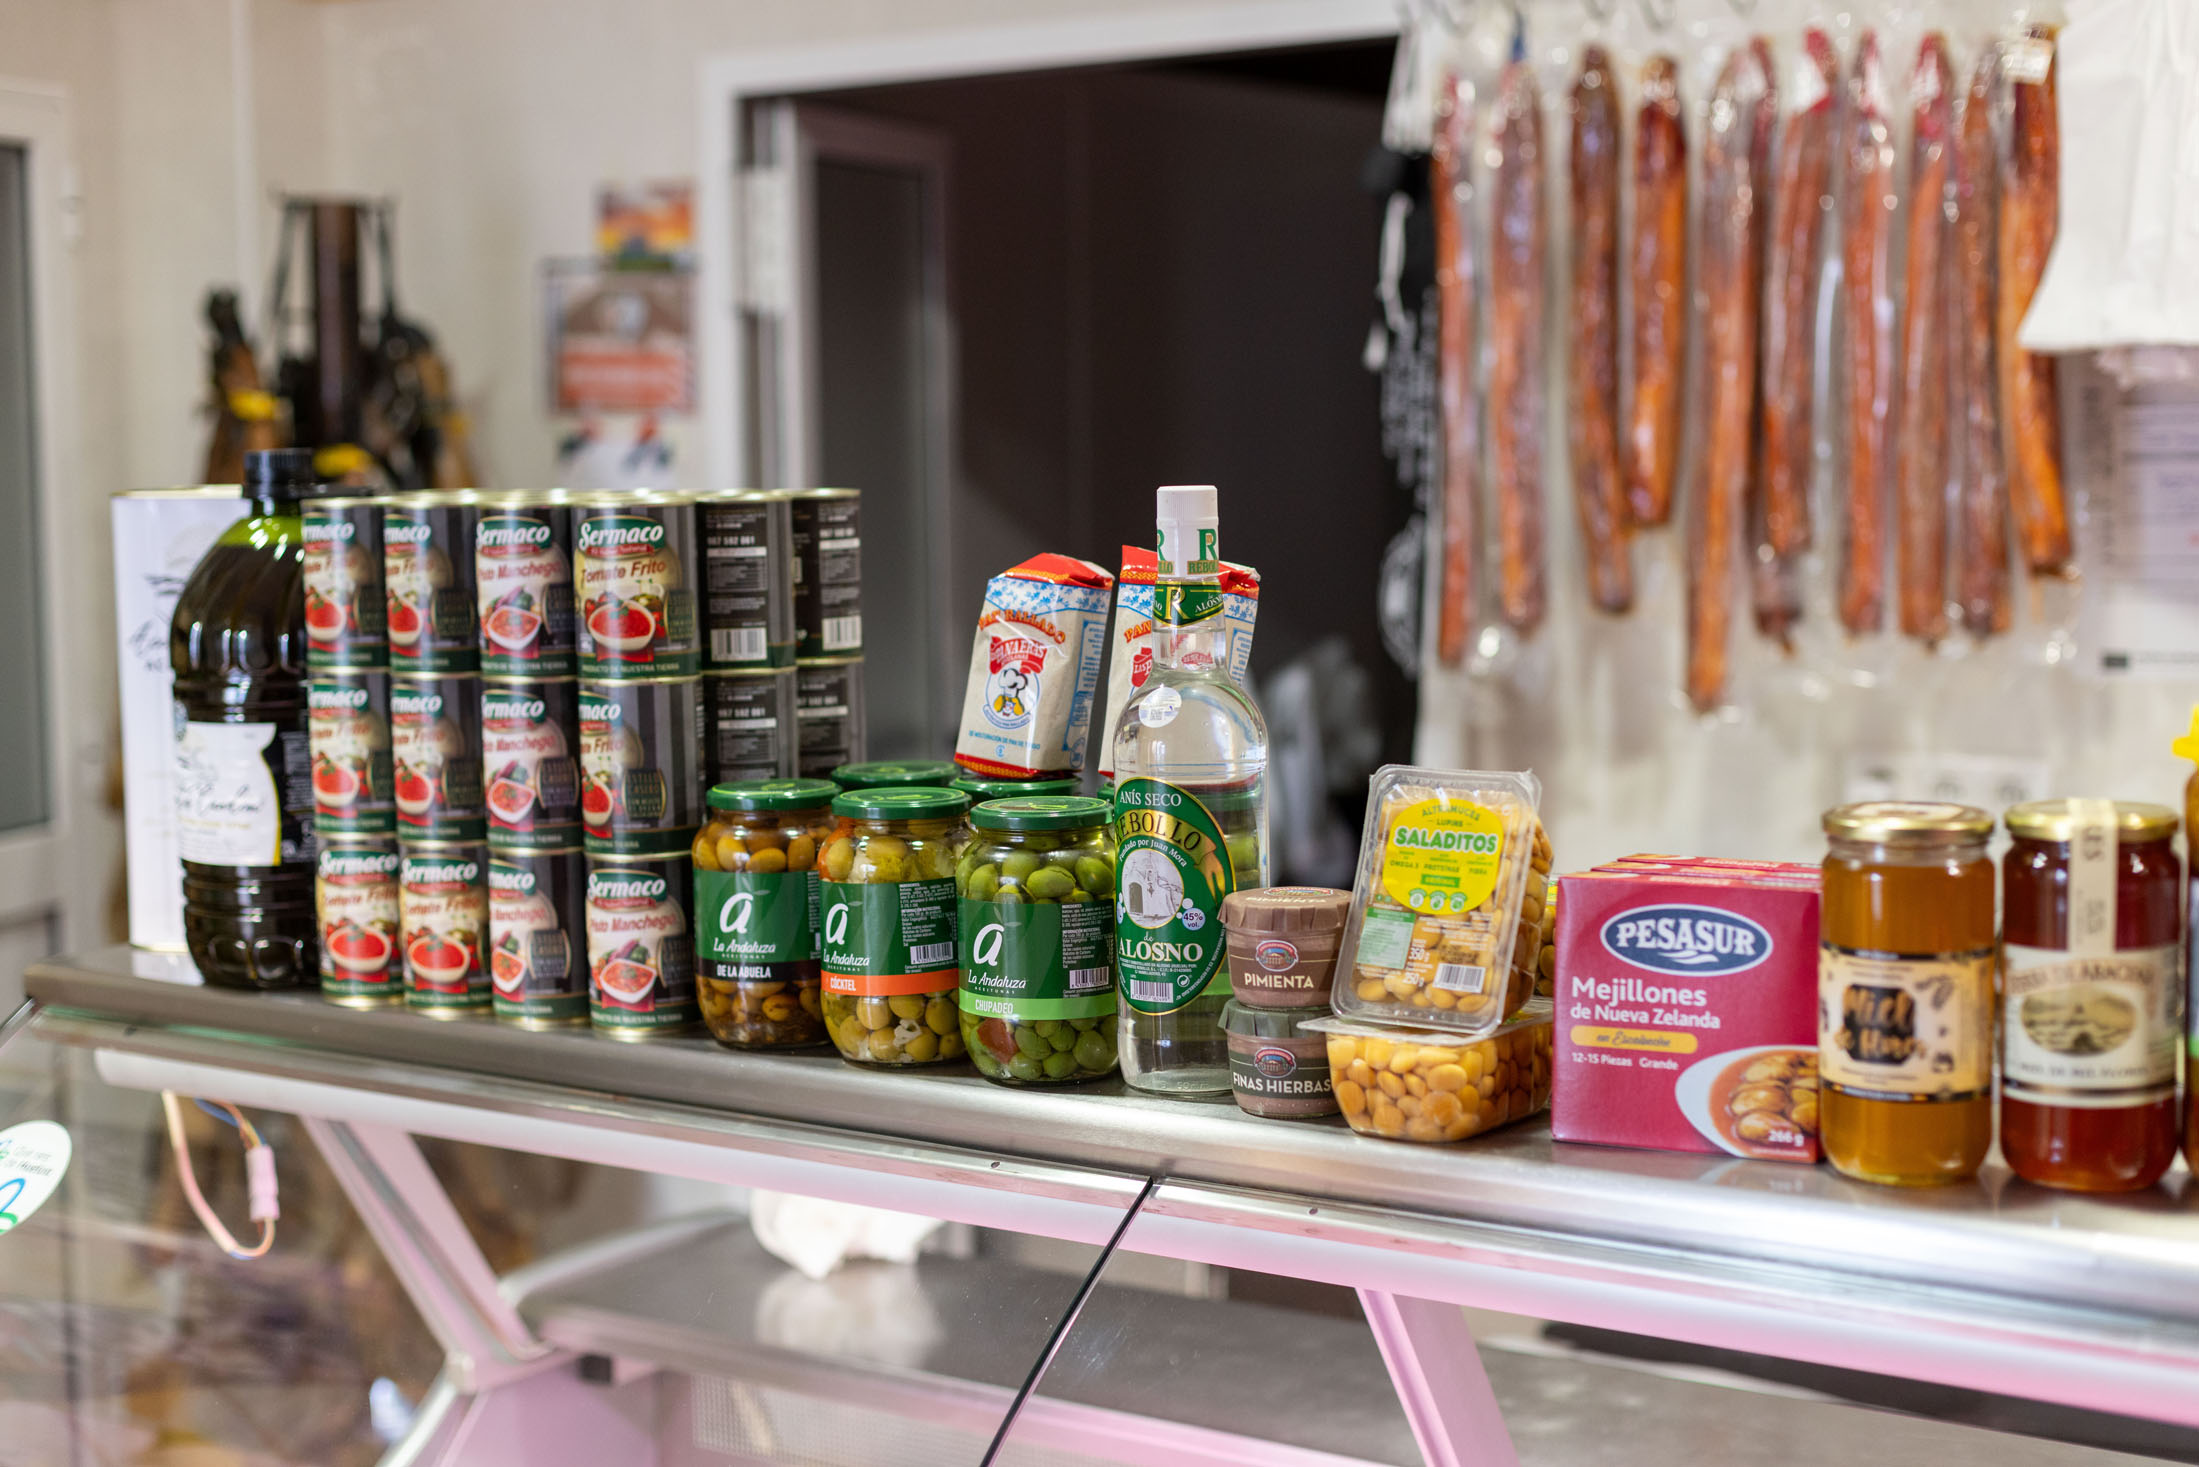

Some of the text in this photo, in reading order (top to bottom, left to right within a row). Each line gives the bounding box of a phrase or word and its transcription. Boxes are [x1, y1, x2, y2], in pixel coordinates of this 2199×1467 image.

[579, 522, 664, 551] Sermaco
[1196, 529, 1219, 561] R
[630, 558, 667, 577] Frito
[1004, 609, 1066, 645] RALLADO
[1124, 620, 1152, 643] PAN
[1120, 788, 1182, 807] ANÍS SECO
[1395, 826, 1498, 854] SALADITOS
[1137, 839, 1149, 848] por
[1150, 840, 1169, 852] Juan
[1168, 847, 1188, 868] Mora
[588, 874, 666, 899] Sermaco
[1182, 912, 1204, 922] 45%
[713, 937, 777, 954] La Andaluza
[1616, 917, 1757, 957] PESASUR
[823, 948, 871, 967] La Andaluza
[1118, 938, 1204, 963] ALOSNO
[716, 963, 772, 979] DE LA ABUELA
[968, 968, 1027, 990] La Andaluza
[1244, 972, 1314, 989] PIMIENTA
[830, 976, 857, 992] CÓCKTEL
[1571, 976, 1707, 1007] Mejillones
[975, 998, 1014, 1015] CHUPADEO
[1570, 1001, 1721, 1029] de Nueva Zelanda
[1571, 1052, 1679, 1071] 12-15 Piezas Grande
[1232, 1071, 1332, 1094] FINAS HIERBAS
